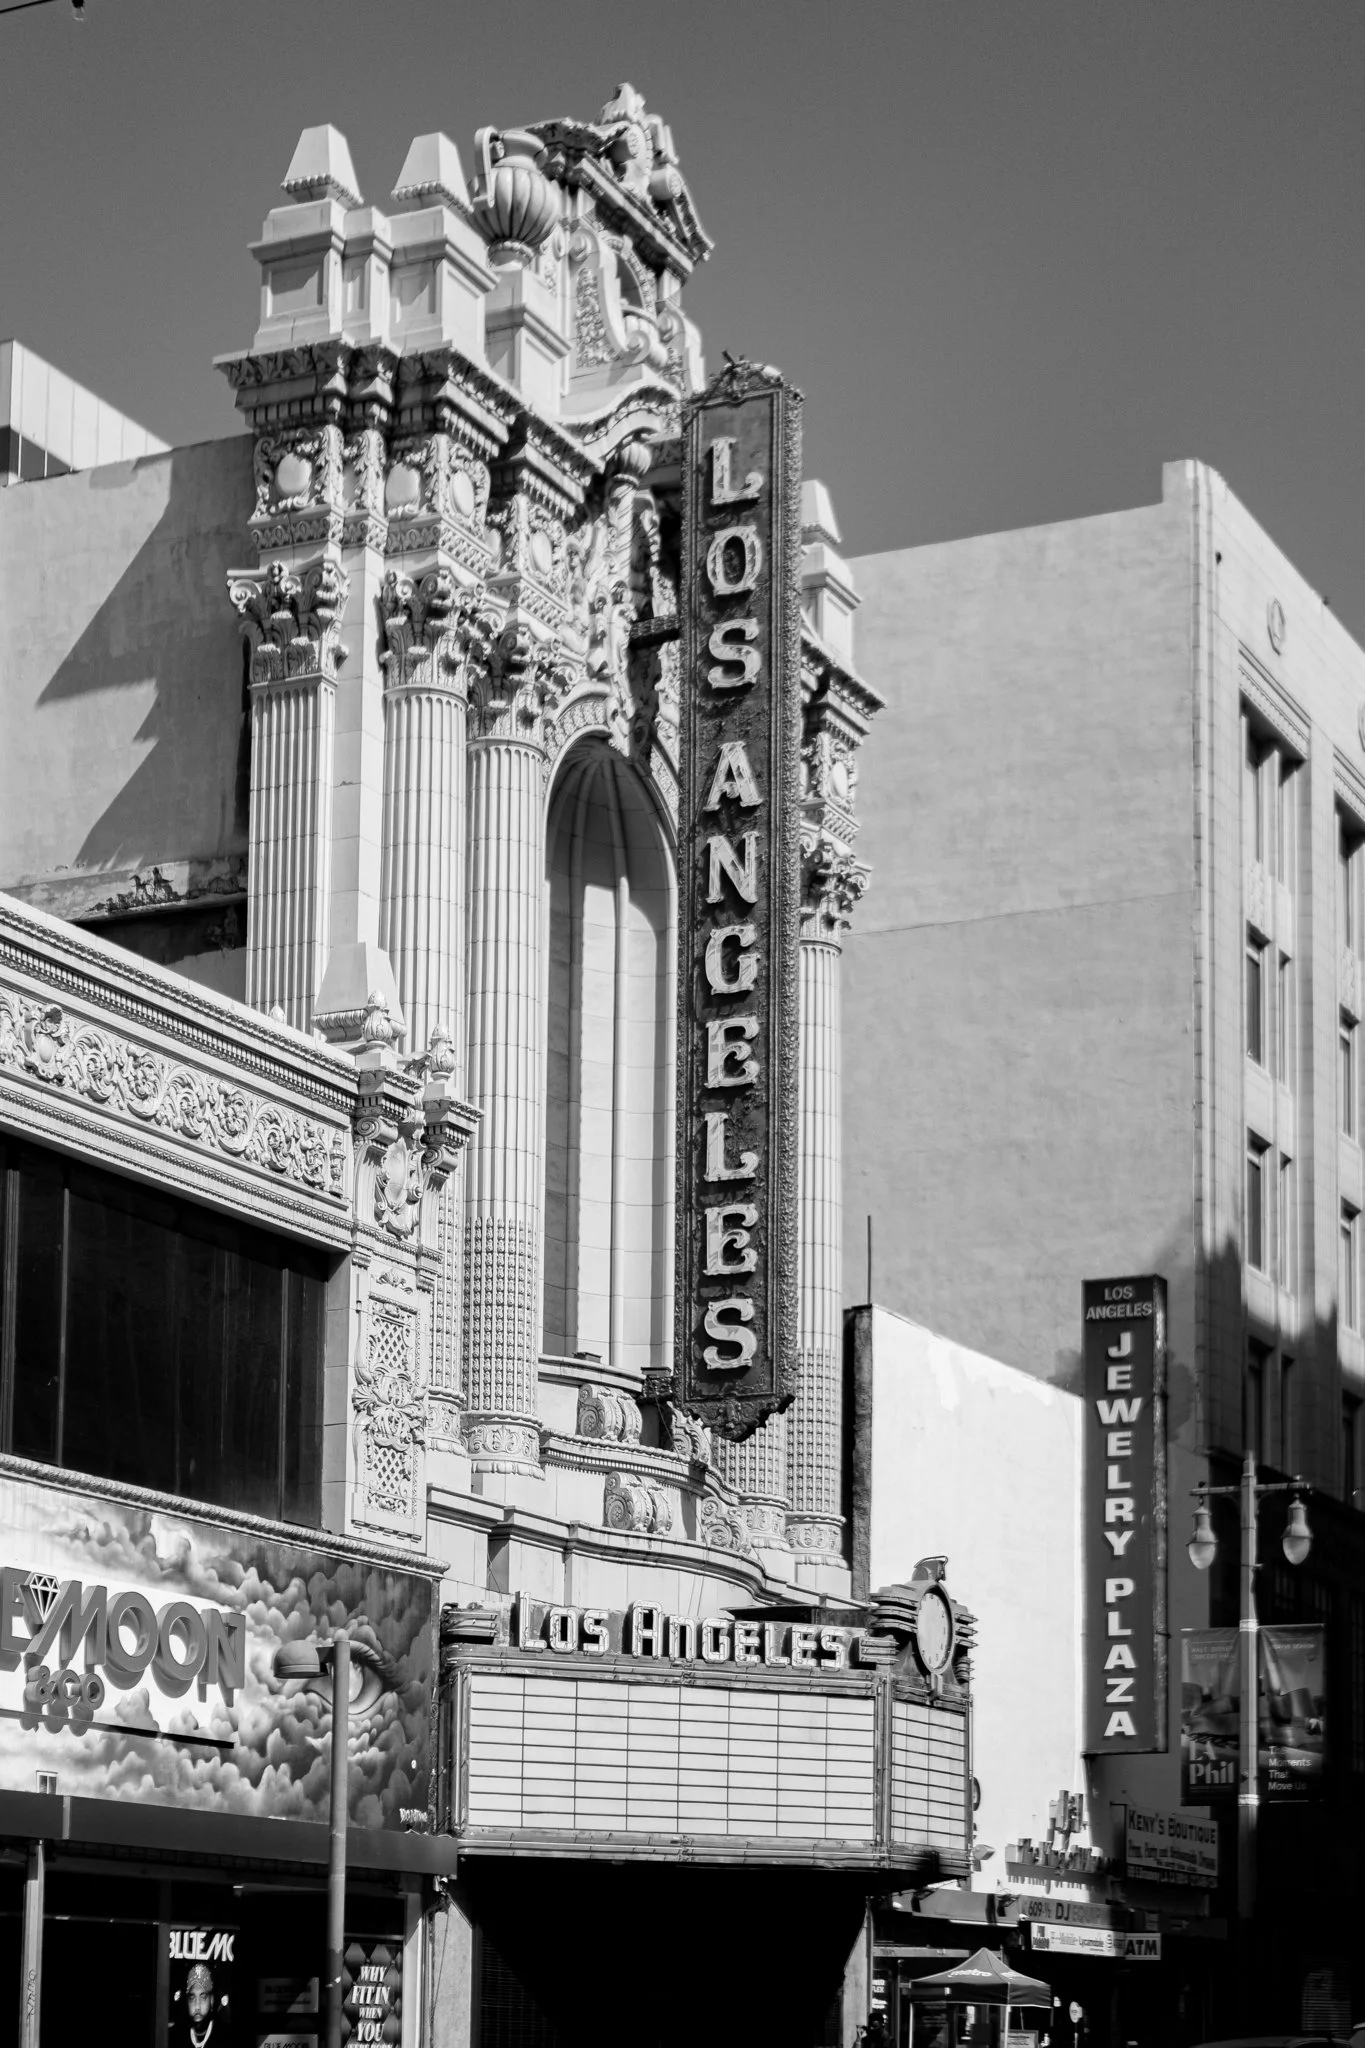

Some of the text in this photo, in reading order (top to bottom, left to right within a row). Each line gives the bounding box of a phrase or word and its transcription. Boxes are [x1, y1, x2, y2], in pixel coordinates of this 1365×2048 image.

[702, 433, 763, 1369] LOS ANGELES
[1103, 1286, 1134, 1301] LOS
[1085, 1302, 1153, 1320] ANGELES
[1097, 1331, 1143, 1737] JEWELRY PLAZA
[517, 1590, 612, 1655] LOS
[22, 1579, 247, 1691] MOON
[1268, 1758, 1313, 1767] Moments
[1189, 1761, 1235, 1785] Phil
[1268, 1781, 1293, 1791] Move
[1128, 1809, 1217, 1845] KENY'S BOUTIQUE
[1055, 1902, 1070, 1921] DJ
[1126, 1939, 1158, 1956] ATM
[360, 1965, 387, 1982] WHY
[351, 1986, 391, 2006] FIT IN
[359, 2007, 383, 2020] WHEN
[356, 2021, 385, 2043] YOU
